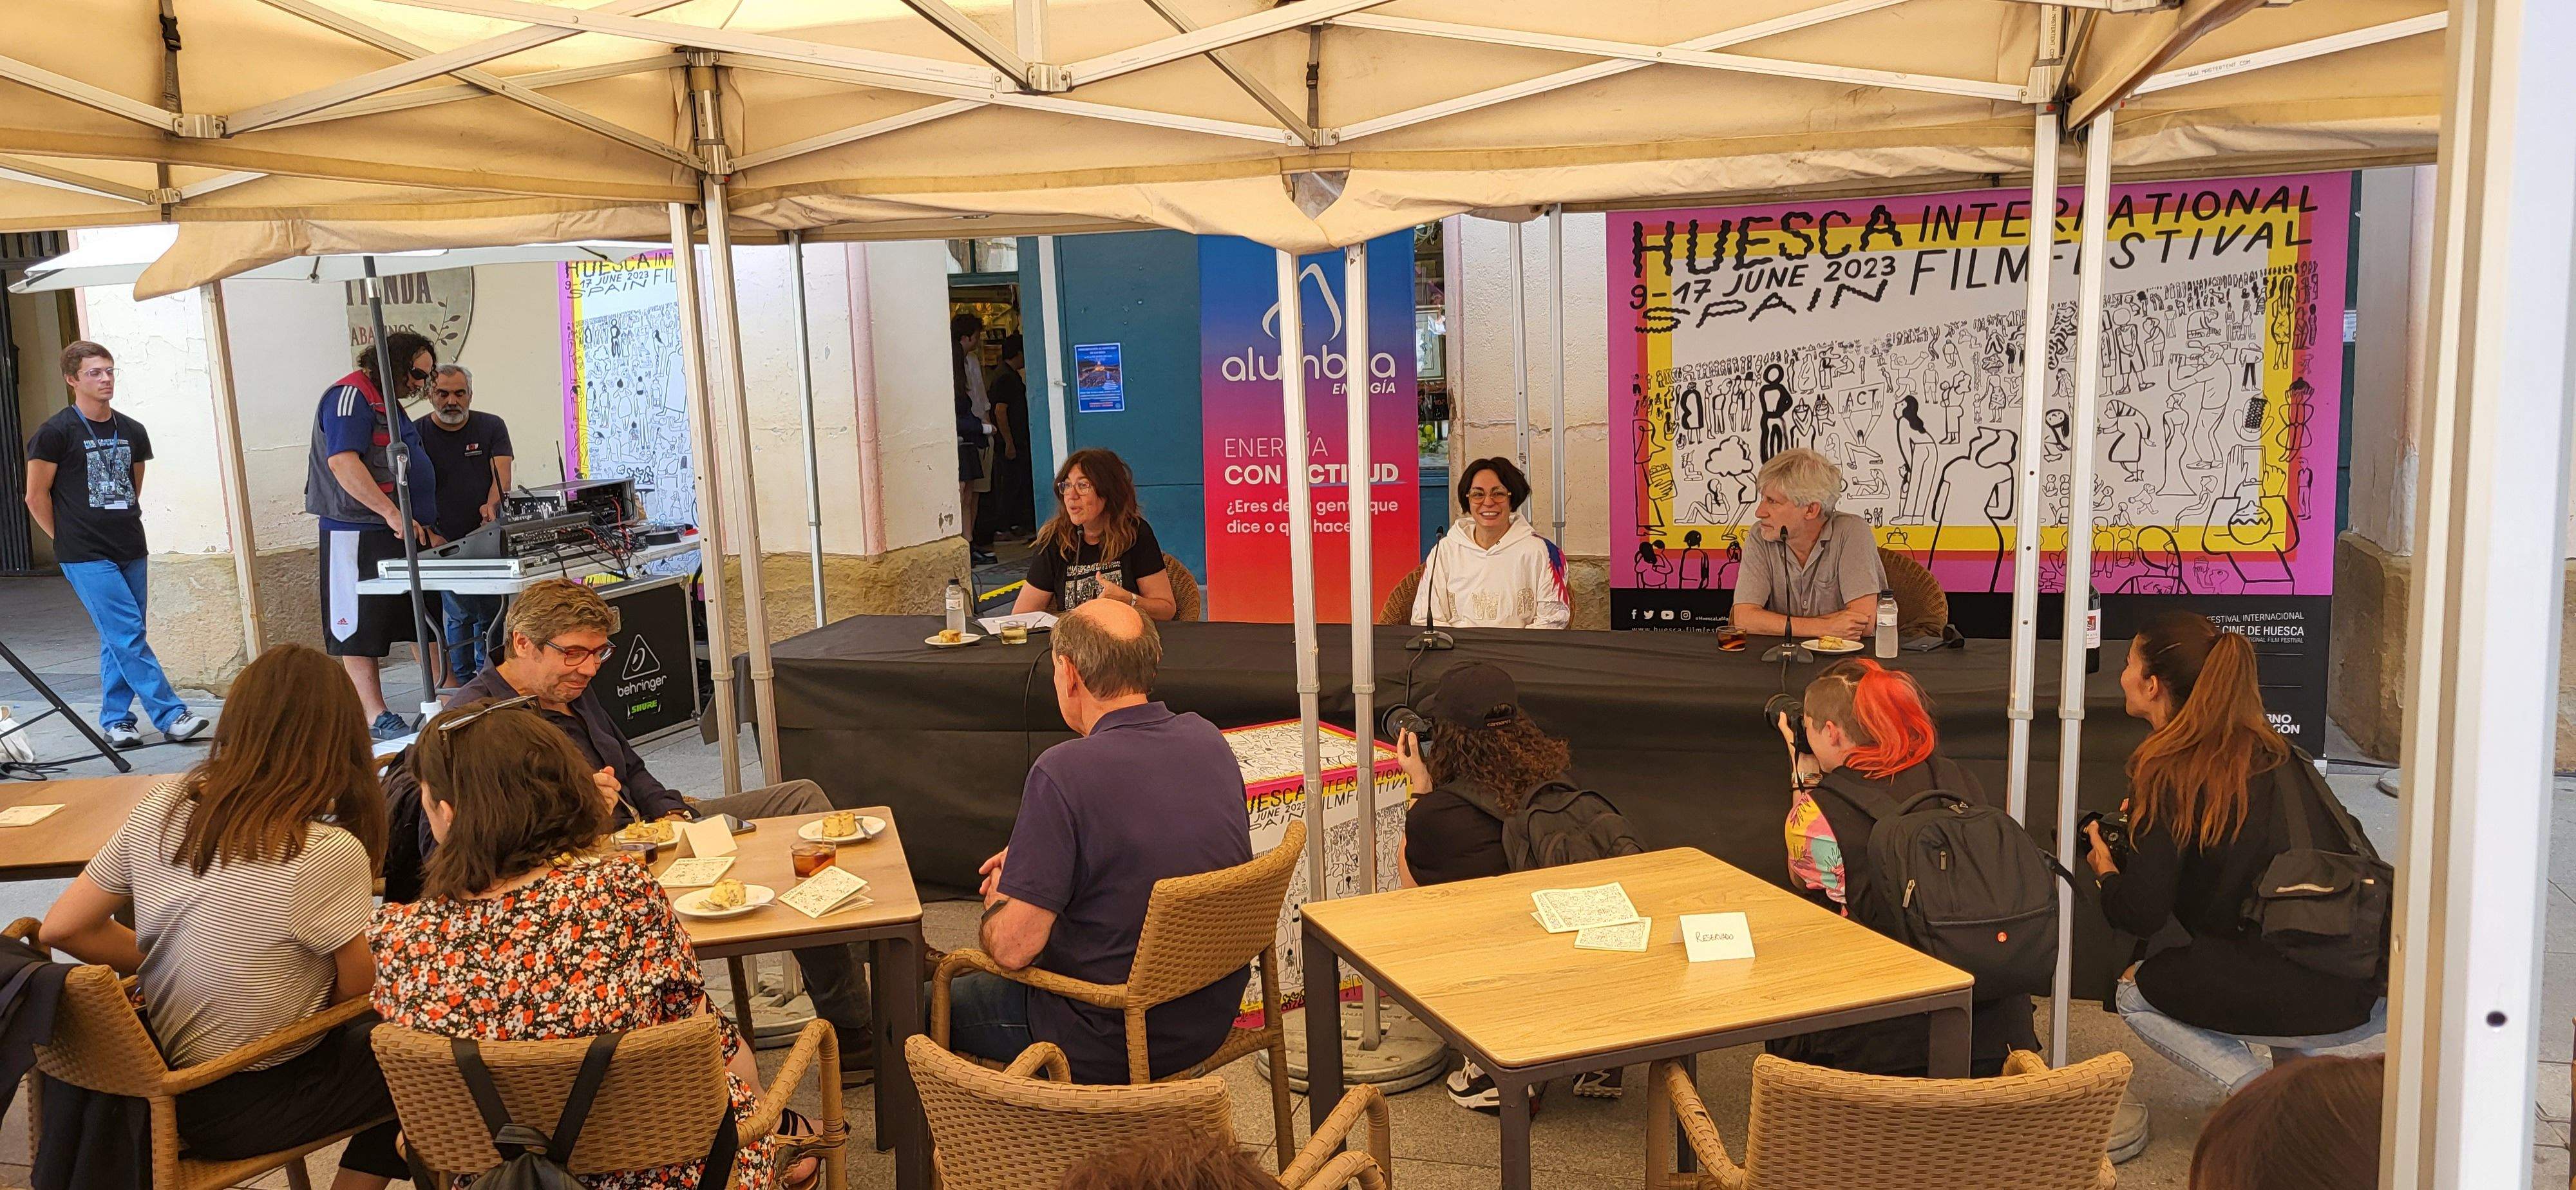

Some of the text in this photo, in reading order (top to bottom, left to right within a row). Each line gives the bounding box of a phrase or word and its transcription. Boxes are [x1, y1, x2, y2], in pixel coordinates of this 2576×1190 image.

[1633, 185, 2318, 278] HUESCA INTERATIONAL
[654, 252, 674, 267] INT
[1909, 220, 2313, 297] FILMSTIVAL
[595, 276, 622, 286] JUNE
[653, 268, 676, 285] FIL
[1722, 263, 1810, 298] JUNE
[1823, 256, 1896, 283] 2023
[345, 272, 433, 306] TINDA
[567, 279, 647, 299] SPAIN
[1634, 279, 1888, 334] SPAIN
[1222, 345, 1396, 381] aluba
[1332, 379, 1396, 395] ENGÍA
[1846, 388, 1879, 408] ACT
[1224, 431, 1329, 458] ENERÍA
[1224, 463, 1399, 485] CON CTIUD
[1226, 498, 1399, 515] ¿Eres de gen que
[1226, 518, 1260, 533] dice
[1264, 522, 1275, 533] o
[1313, 518, 1350, 533] hace
[2242, 612, 2305, 622] INTERNACIONAL
[2222, 625, 2305, 636] CINE DE HUESCA
[617, 675, 667, 697] behringer
[631, 699, 658, 714] SHURE
[2266, 713, 2292, 724] RNO
[2273, 724, 2300, 734] GON
[1249, 784, 1305, 815] ESCA
[1249, 810, 1305, 831] PAIN
[1255, 801, 1306, 824] JUNE 2023
